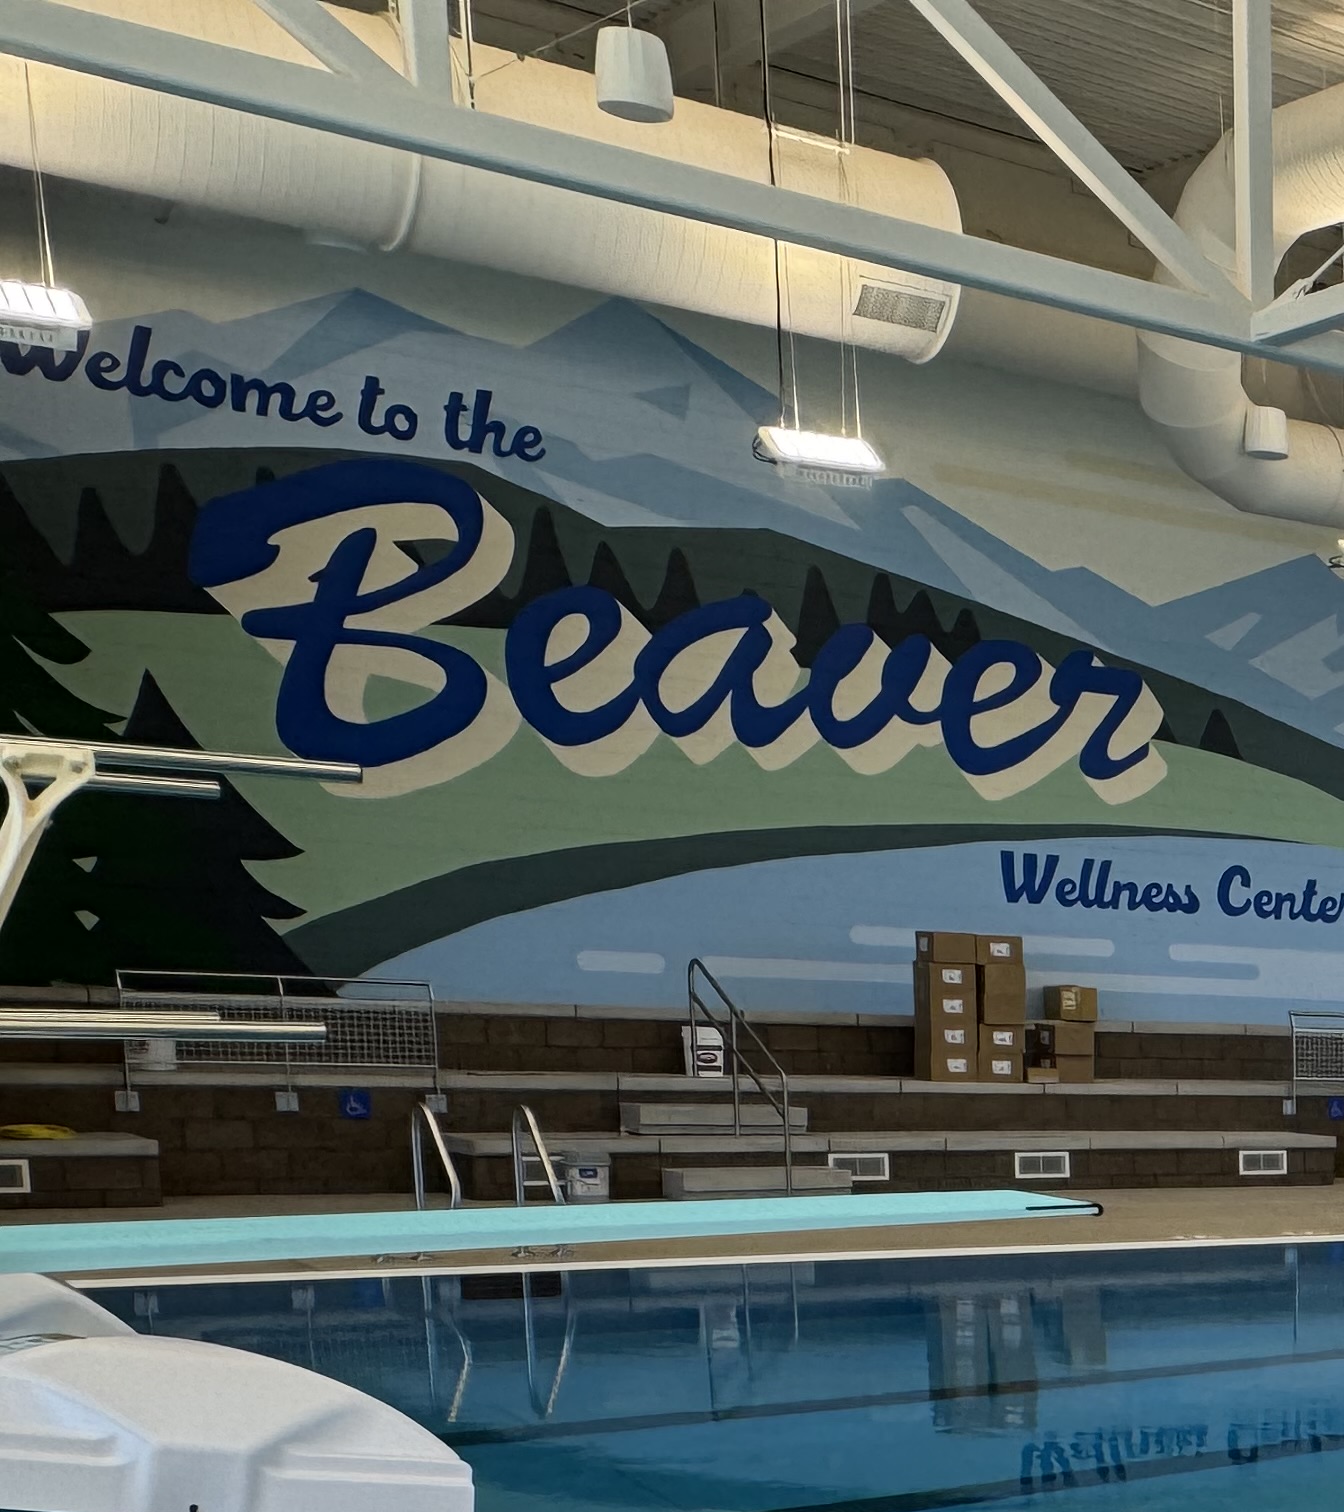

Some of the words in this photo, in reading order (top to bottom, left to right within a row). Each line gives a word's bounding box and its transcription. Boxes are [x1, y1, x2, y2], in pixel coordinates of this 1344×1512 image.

[358, 375, 418, 441] to
[443, 389, 547, 462] the
[189, 458, 1153, 781] Beaver
[1000, 850, 1200, 914] Wellness
